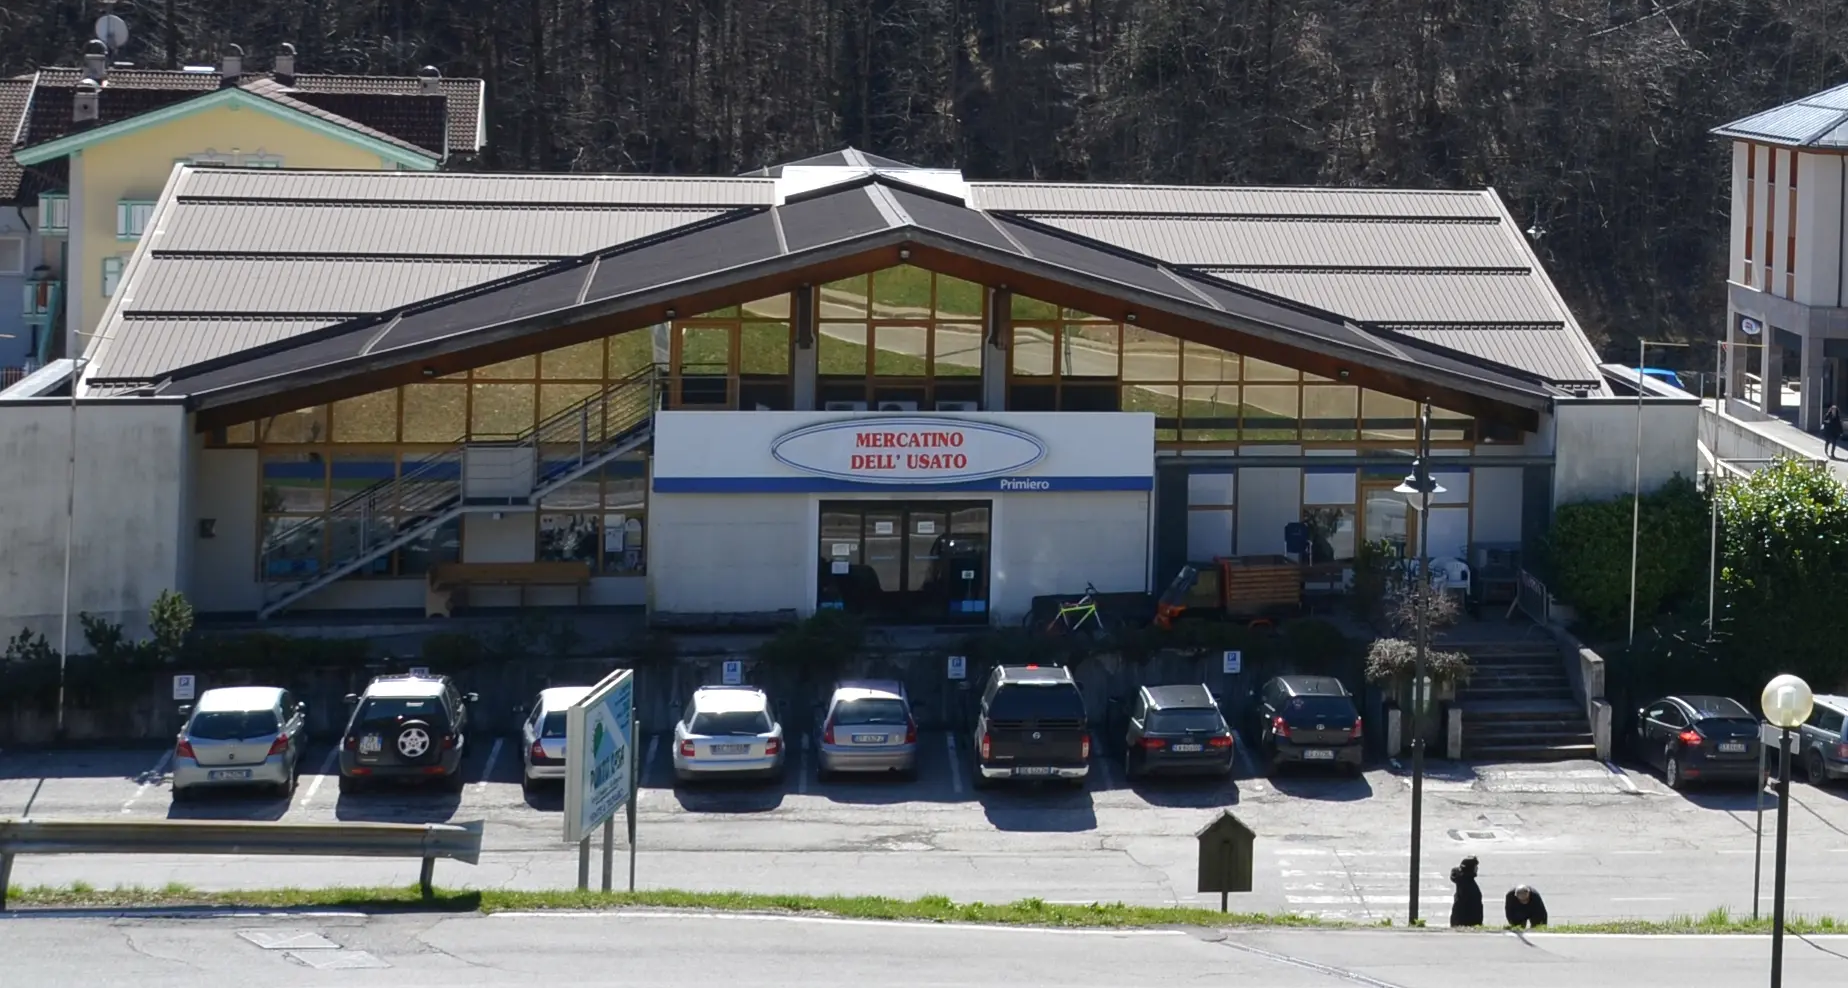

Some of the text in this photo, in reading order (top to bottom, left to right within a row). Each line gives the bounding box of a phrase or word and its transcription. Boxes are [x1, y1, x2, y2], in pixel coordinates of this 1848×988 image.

[855, 432, 964, 448] MERCATINO
[850, 454, 968, 470] DELL' USATO
[1000, 479, 1050, 490] Primiero
